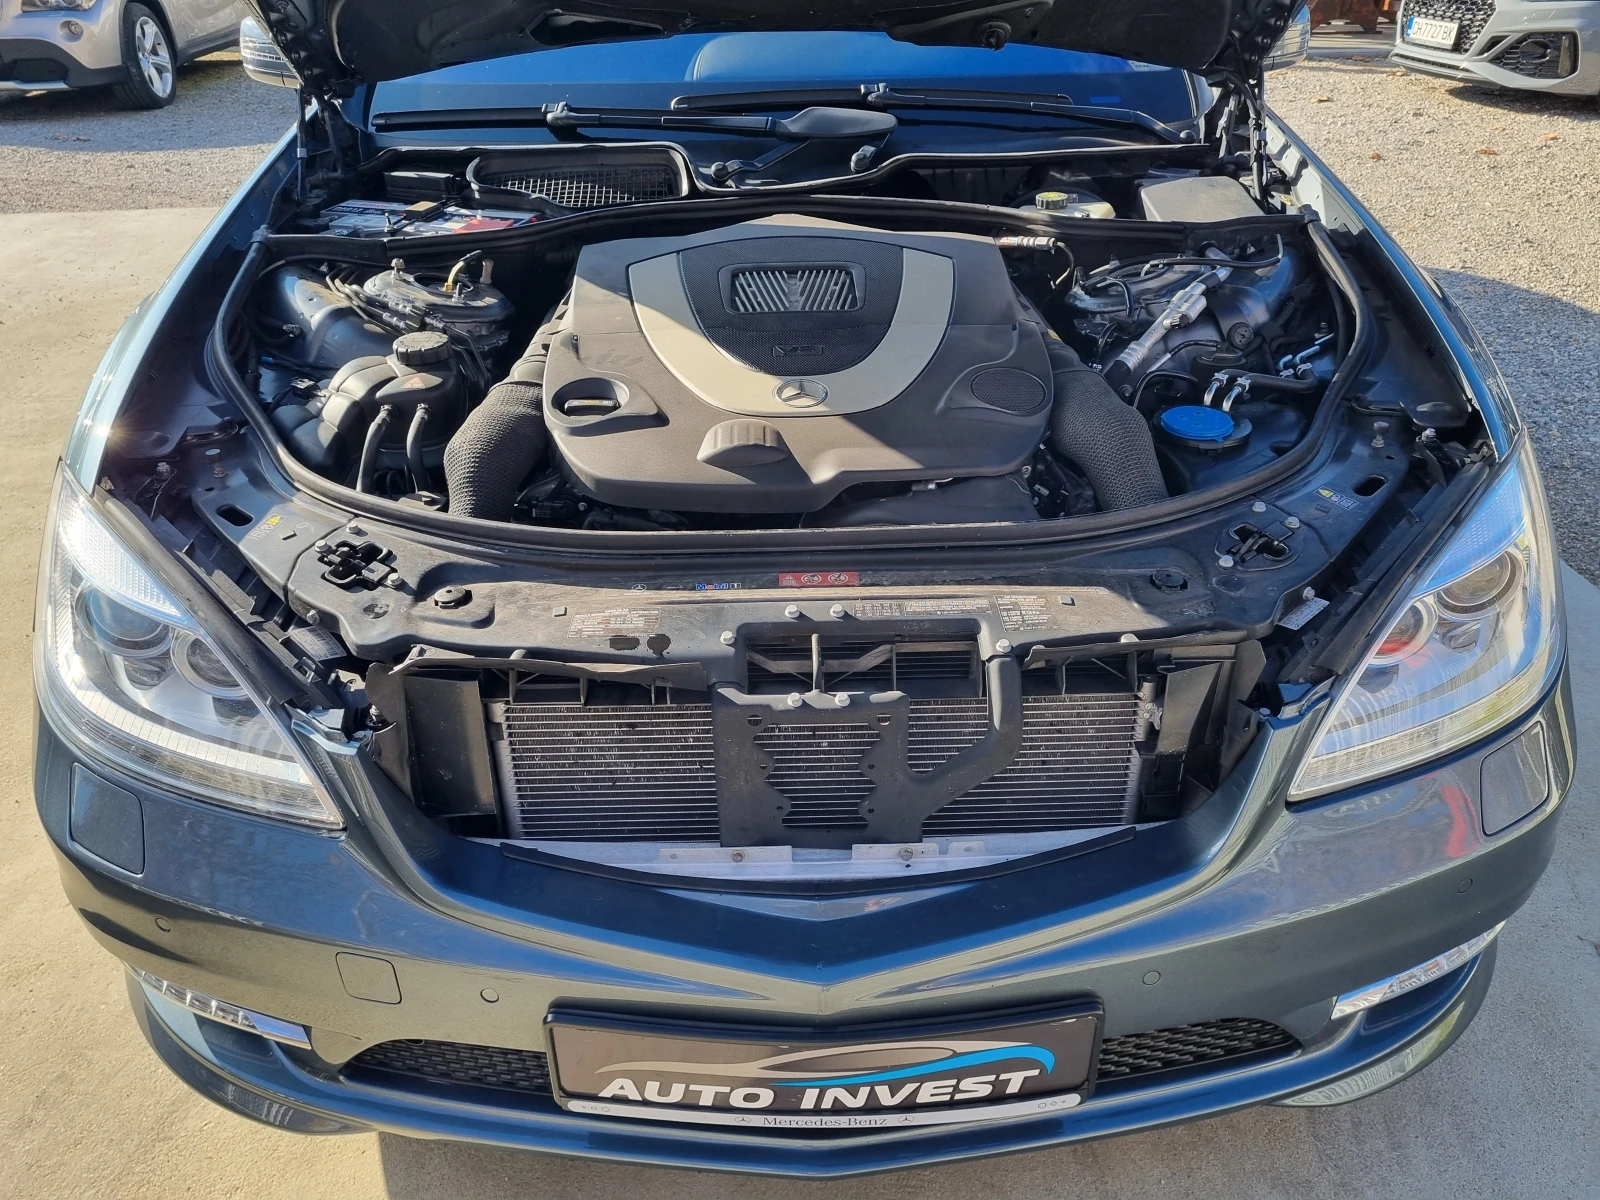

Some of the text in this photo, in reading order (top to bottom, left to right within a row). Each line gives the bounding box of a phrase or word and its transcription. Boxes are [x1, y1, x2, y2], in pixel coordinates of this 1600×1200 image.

[1422, 23, 1443, 38] 7727
[1441, 26, 1455, 41] BK
[598, 1069, 1041, 1110] AUTO INVEST
[763, 1116, 888, 1127] Mercedes-Benz
